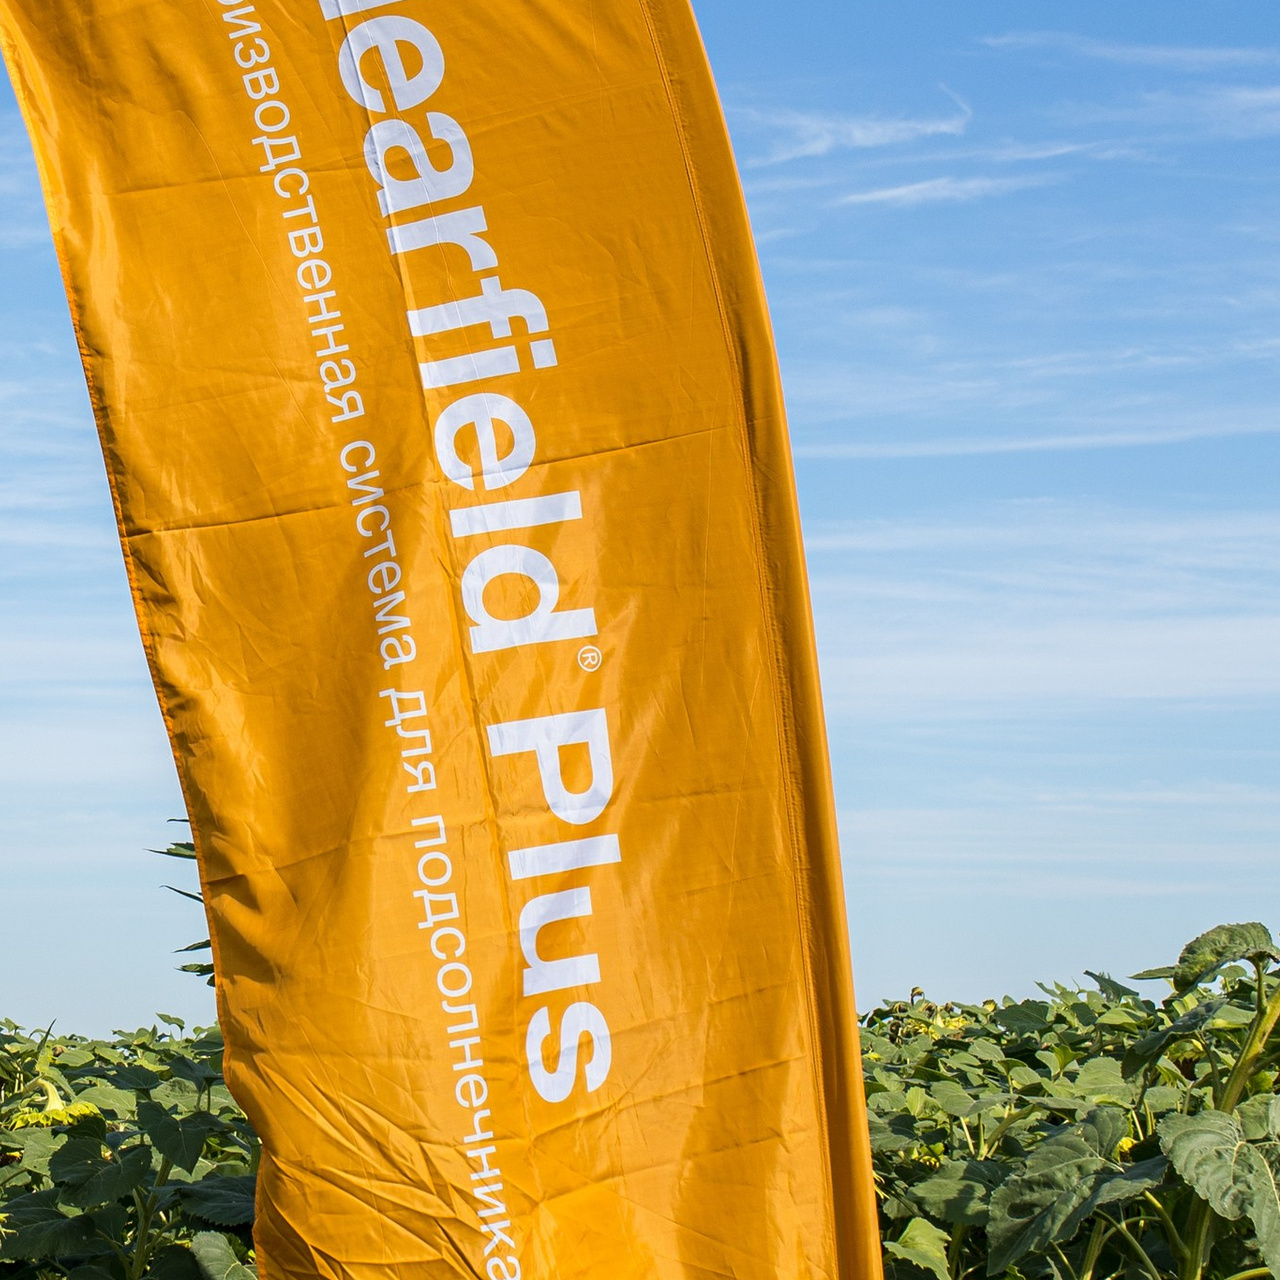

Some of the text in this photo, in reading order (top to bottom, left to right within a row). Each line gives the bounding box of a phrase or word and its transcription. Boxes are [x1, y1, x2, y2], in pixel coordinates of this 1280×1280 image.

[340, 440, 417, 670] система
[378, 688, 437, 793] для
[486, 707, 622, 1104] Plus
